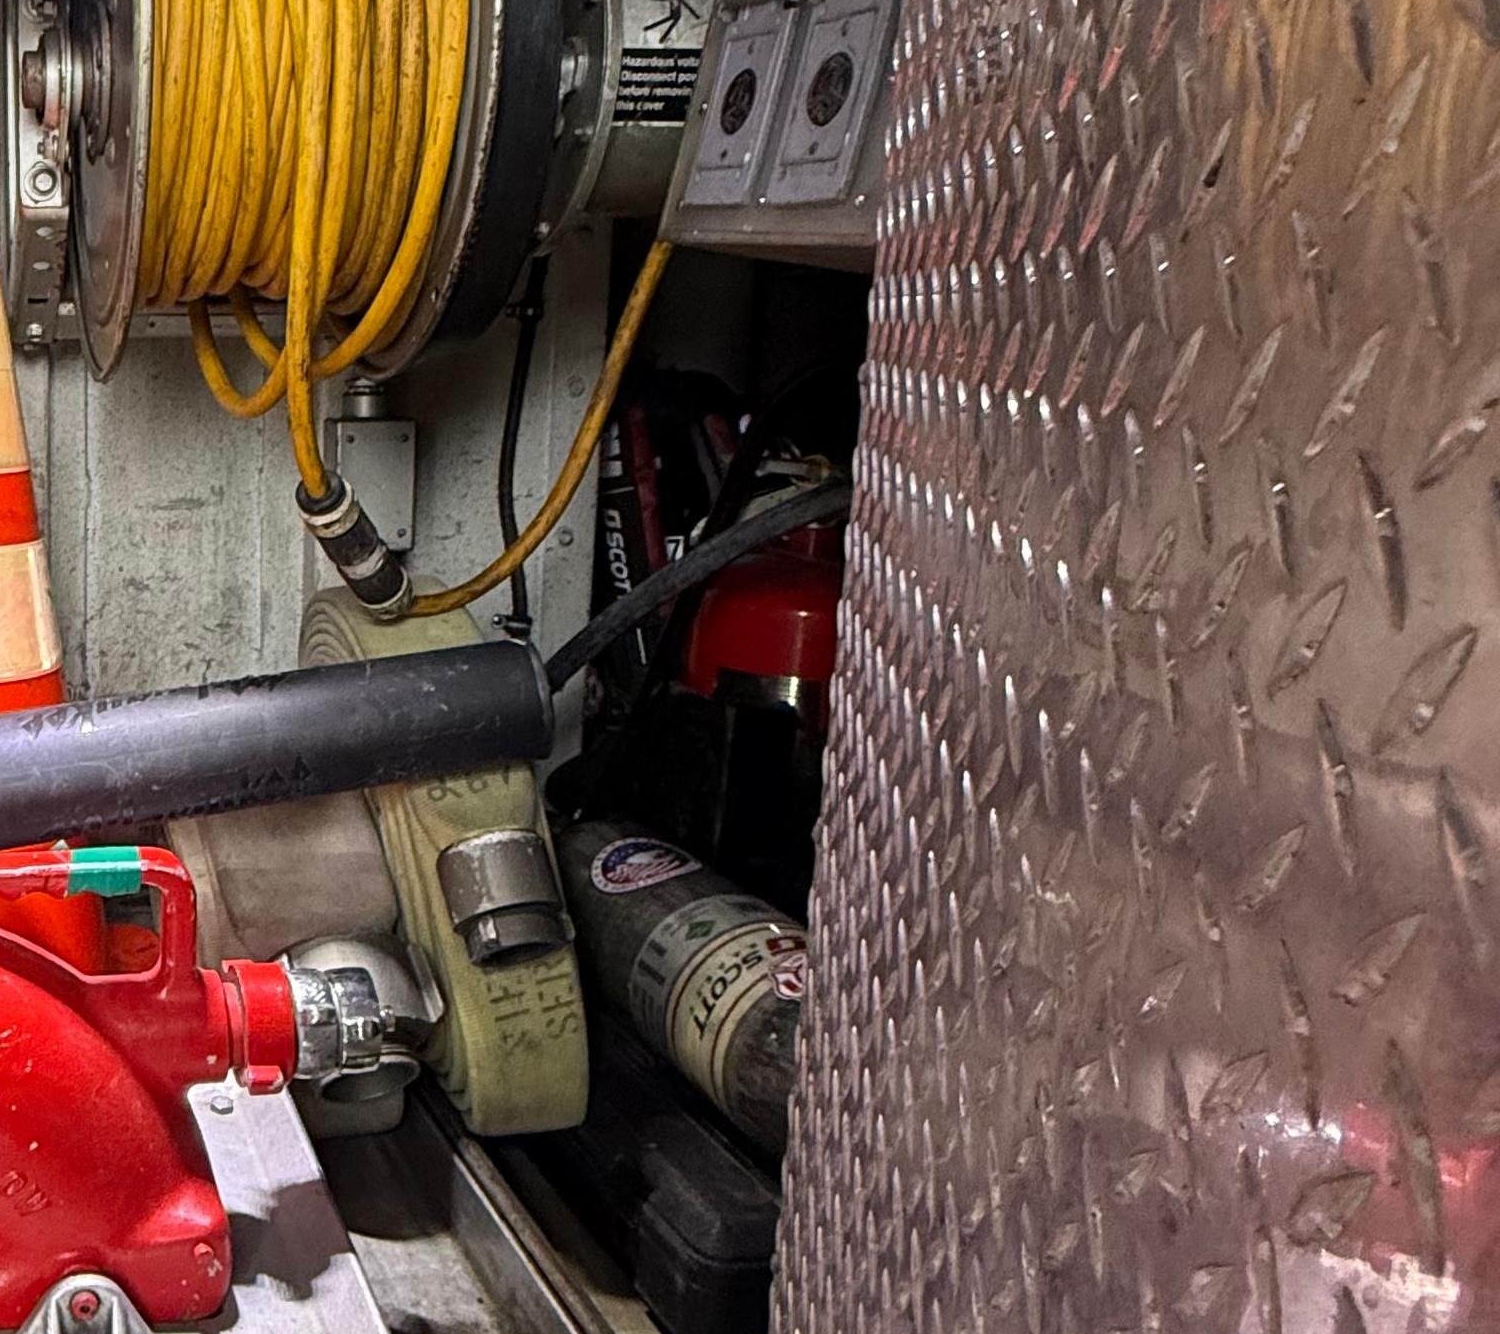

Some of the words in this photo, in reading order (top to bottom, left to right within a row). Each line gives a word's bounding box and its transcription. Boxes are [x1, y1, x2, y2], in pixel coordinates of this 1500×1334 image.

[622, 53, 675, 67] Hazardous
[677, 53, 700, 67] volta
[621, 70, 676, 82] Disconnect
[618, 84, 651, 98] before
[651, 85, 693, 97] removin
[606, 531, 632, 599] SCOT
[693, 949, 764, 1042] SCOTT
